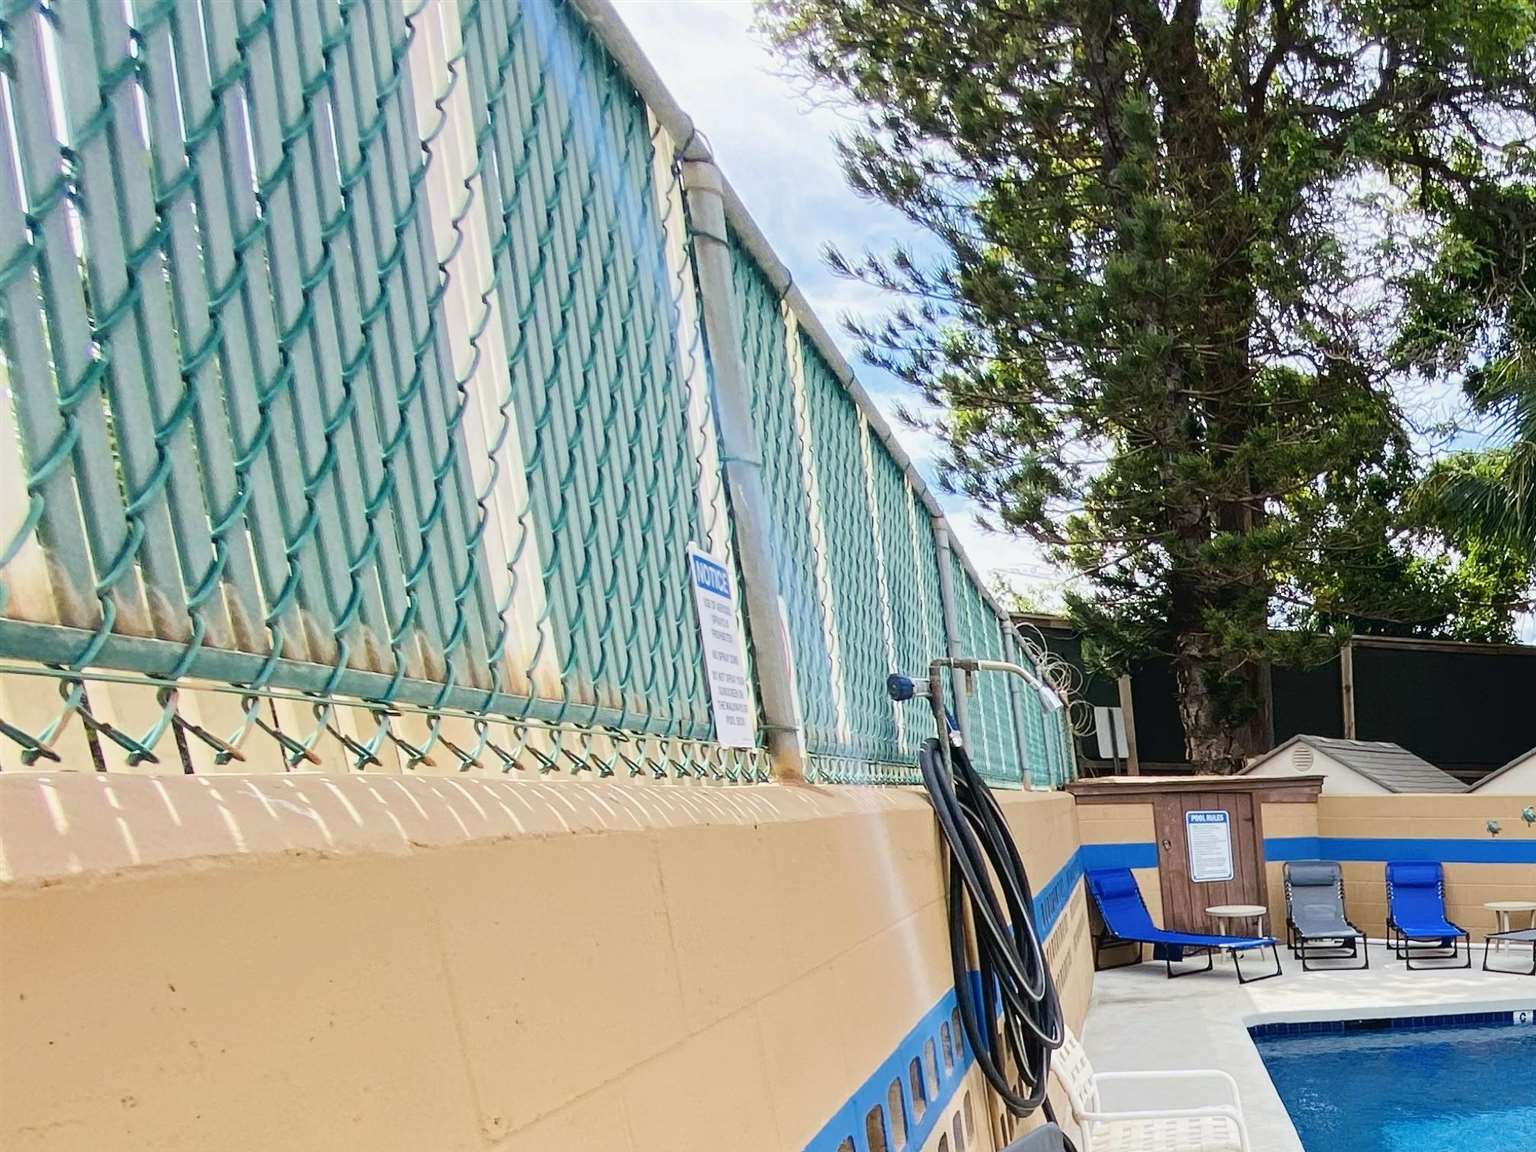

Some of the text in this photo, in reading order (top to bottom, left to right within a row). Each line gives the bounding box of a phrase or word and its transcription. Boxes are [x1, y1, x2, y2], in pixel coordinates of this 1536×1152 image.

[695, 561, 729, 594] NOTICE
[1191, 814, 1224, 822] POOL RULES
